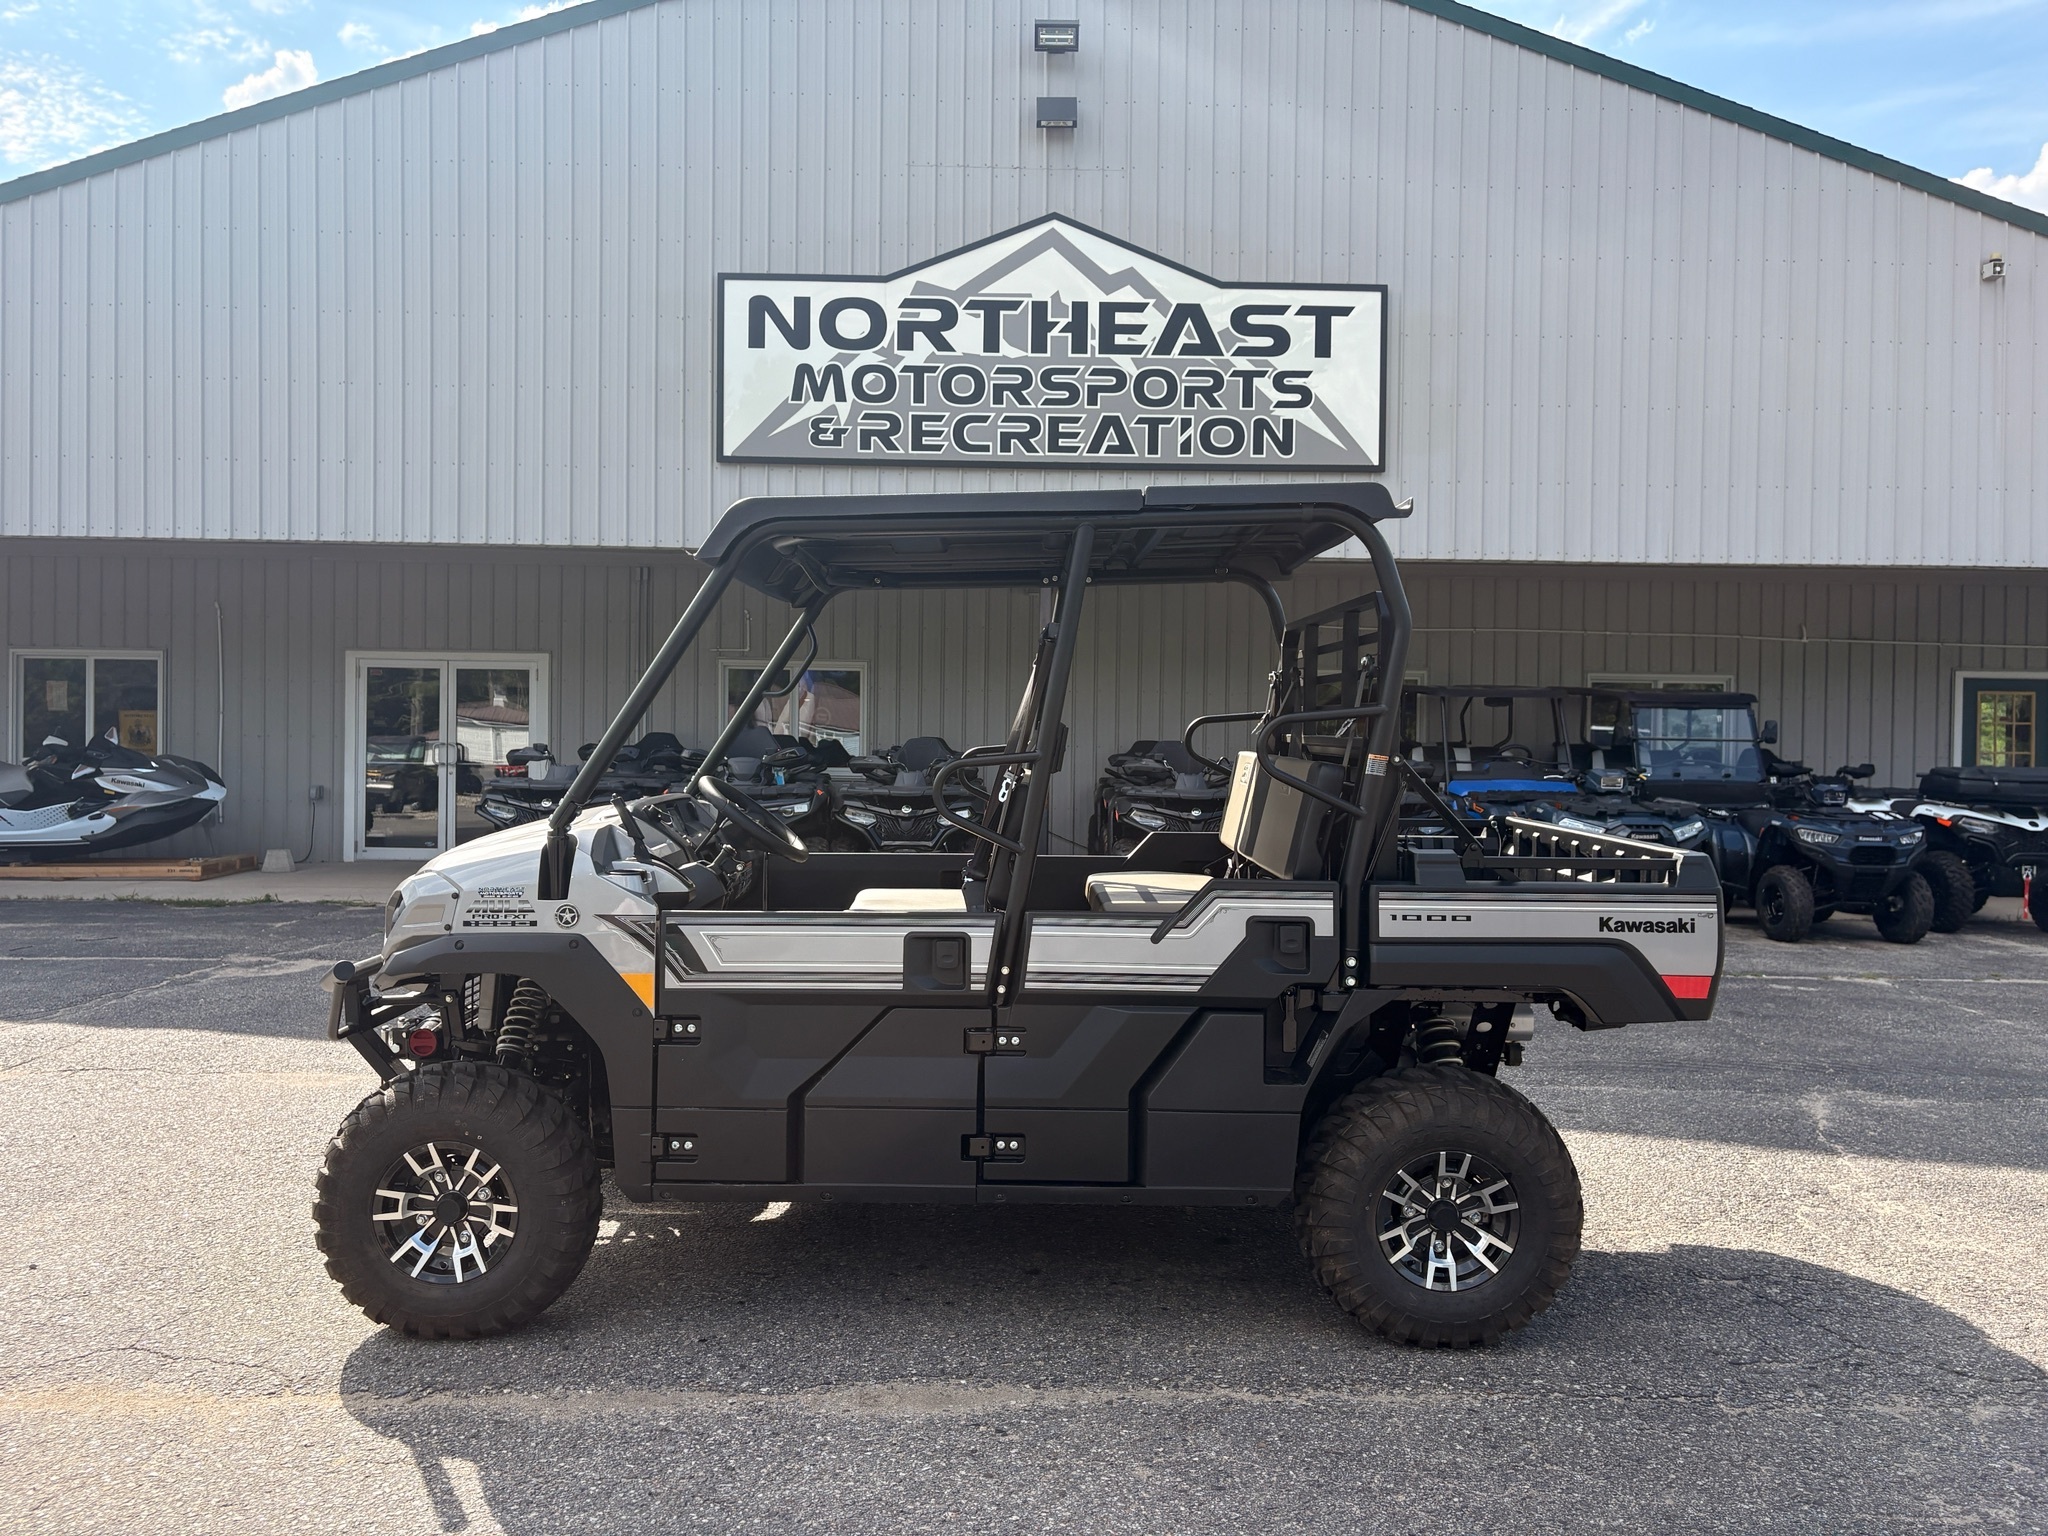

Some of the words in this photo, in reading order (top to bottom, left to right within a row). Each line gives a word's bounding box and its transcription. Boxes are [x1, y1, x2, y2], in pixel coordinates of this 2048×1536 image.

[747, 295, 1354, 358] NORTHEAST
[789, 363, 1313, 409] MOTORSPORTS
[111, 777, 145, 788] Kawasaki
[465, 899, 536, 914] MULE
[1599, 916, 1696, 934] Kawasaki
